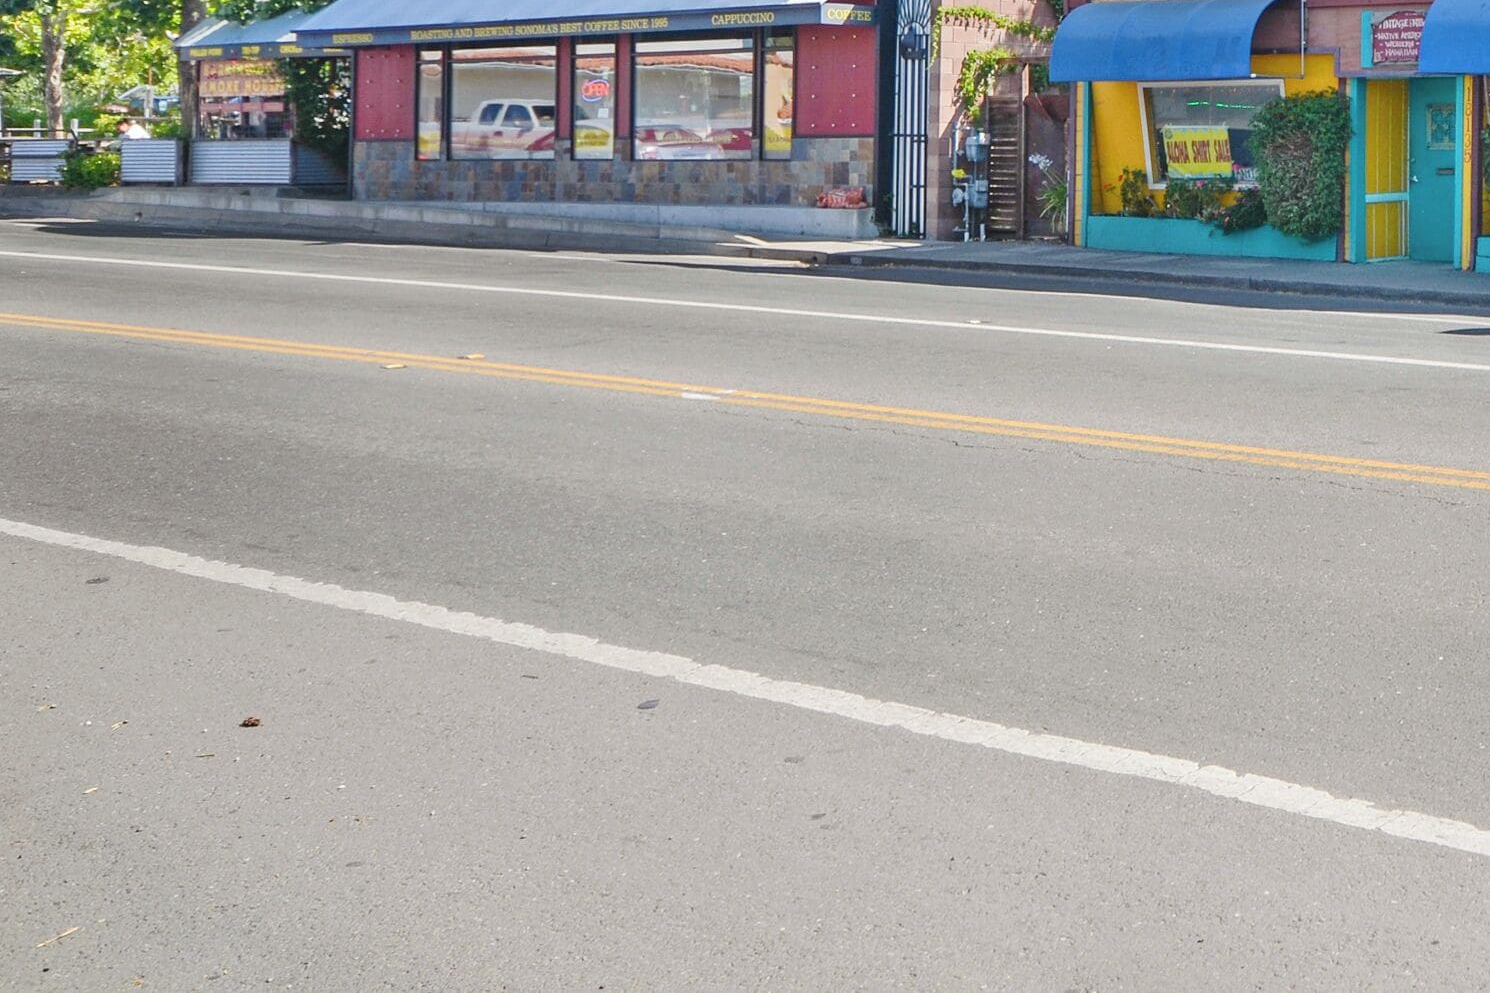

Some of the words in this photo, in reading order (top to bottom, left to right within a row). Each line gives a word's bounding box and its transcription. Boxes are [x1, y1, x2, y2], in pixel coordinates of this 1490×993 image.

[711, 11, 775, 26] CAPPUCCINO
[827, 8, 872, 22] COFFEE
[410, 26, 453, 41] ROASTING
[454, 27, 473, 39] AND
[474, 24, 514, 38] BREWING
[514, 23, 559, 36] SONOMA'S
[560, 21, 583, 34] BEST
[584, 19, 621, 32] COFFEE
[621, 17, 649, 30] SINCE
[582, 82, 609, 97] OPEN
[1166, 140, 1190, 163] ALOHA
[1191, 139, 1212, 164] SHIRT
[1213, 138, 1232, 163] SALE
